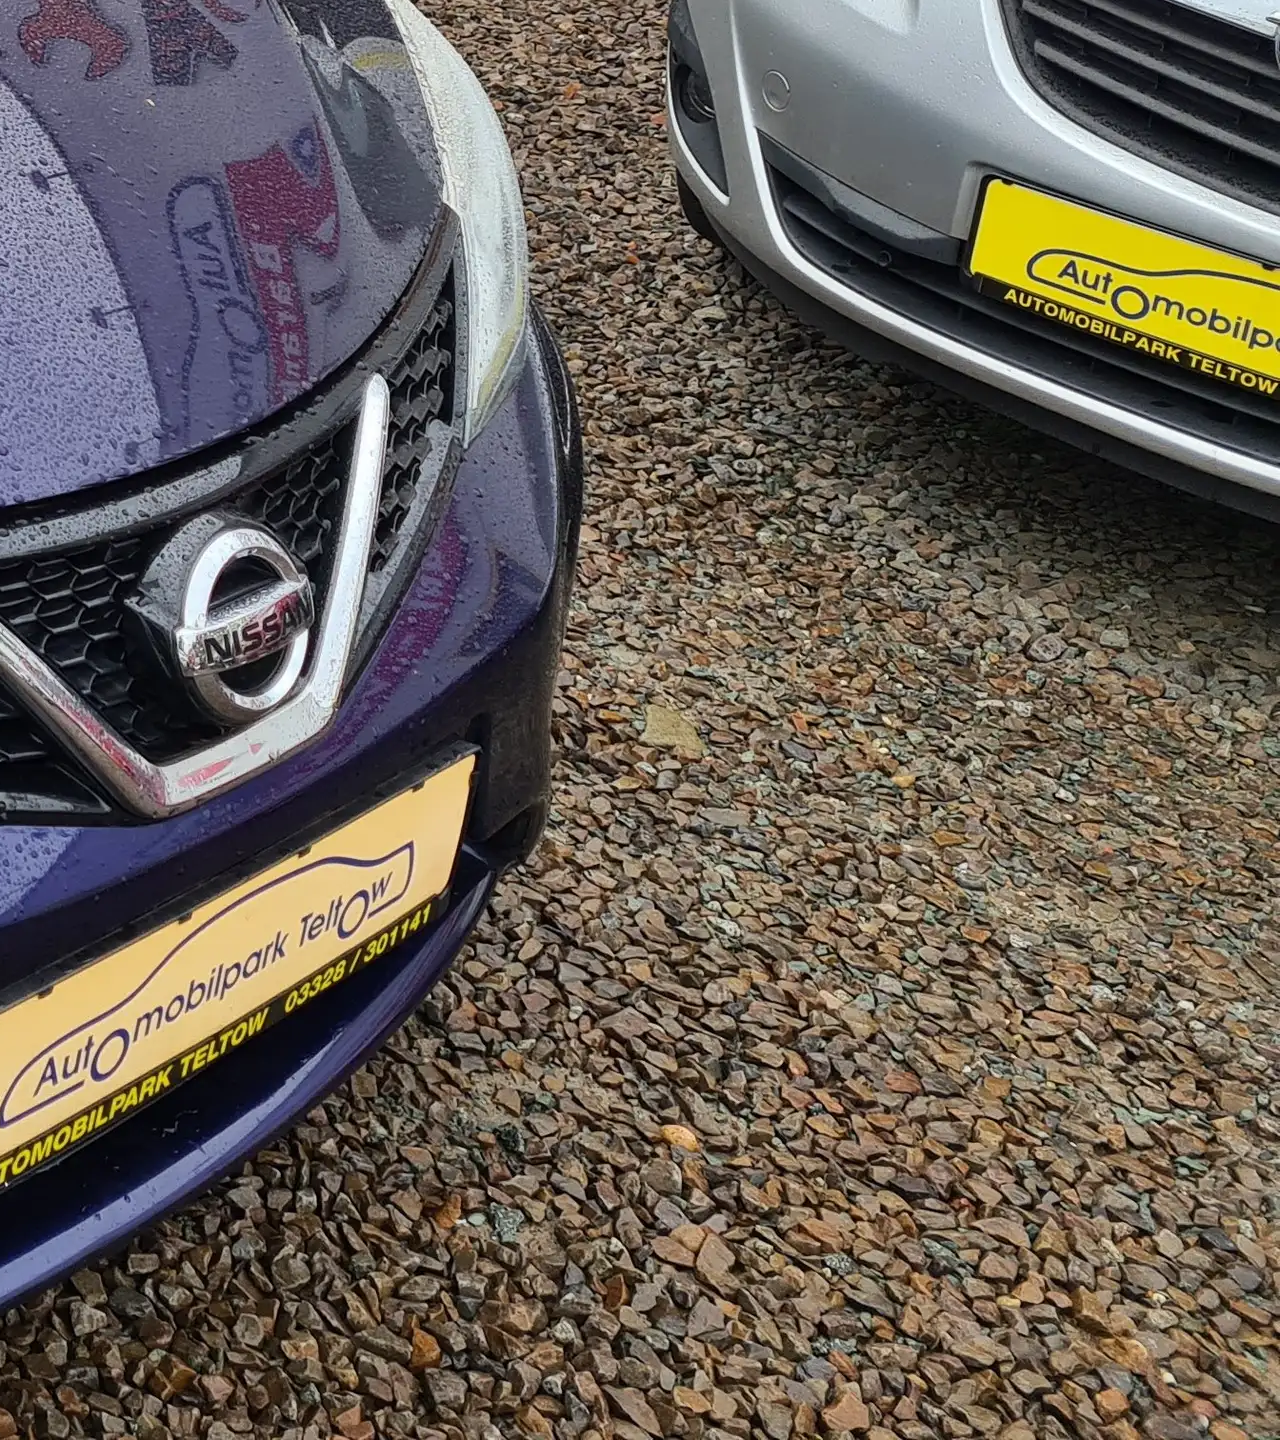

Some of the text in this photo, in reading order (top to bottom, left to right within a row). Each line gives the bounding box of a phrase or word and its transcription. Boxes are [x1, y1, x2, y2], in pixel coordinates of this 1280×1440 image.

[1004, 288, 1280, 396] AUTOMOBILPARK TELTOW
[1057, 260, 1280, 353] Automobilp
[203, 593, 312, 666] NISSAN
[180, 1007, 271, 1076] TELTOW
[284, 964, 347, 1014] 03328
[364, 904, 433, 964] 301141
